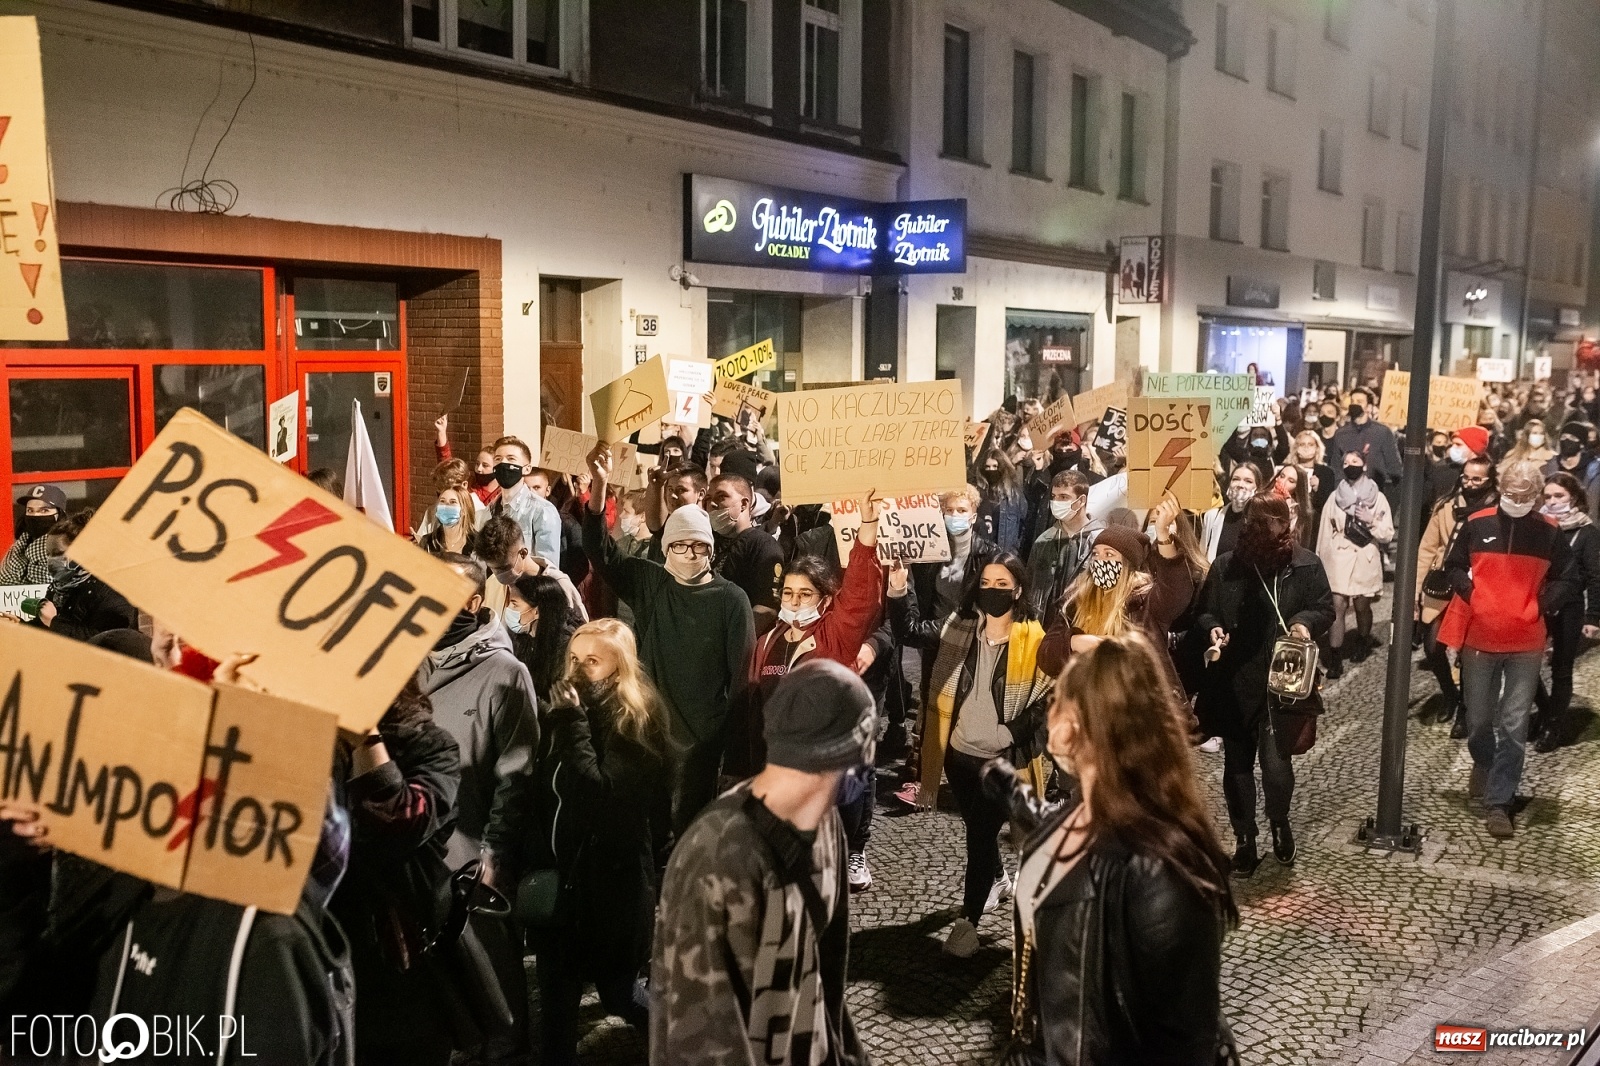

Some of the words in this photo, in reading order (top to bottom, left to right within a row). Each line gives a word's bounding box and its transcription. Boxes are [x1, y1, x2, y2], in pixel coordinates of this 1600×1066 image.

[751, 197, 818, 252] Jubiler
[817, 206, 878, 254] Złotnik
[894, 213, 949, 241] Jubiler
[894, 242, 950, 266] Złotnik
[643, 318, 657, 331] 36
[749, 343, 773, 365] -10%
[1042, 349, 1072, 361] PRZECENA
[723, 381, 740, 392] LOVE
[740, 385, 747, 393] &
[747, 387, 769, 401] PEACE
[1147, 376, 1170, 393] NIE
[1176, 375, 1255, 392] POTRZEBUJE
[786, 397, 819, 423] NO
[831, 388, 954, 420] KACZUSZKO
[1215, 396, 1250, 410] RUCHA
[1029, 397, 1066, 432] WELCOME
[1037, 424, 1048, 435] TO
[1049, 412, 1064, 427] HELL
[1133, 403, 1211, 439] DOŚĆ!
[1246, 410, 1267, 424] PRAW
[786, 425, 852, 450] KONIEC
[912, 420, 960, 441] TERAZ
[784, 452, 809, 475] CIĘ
[821, 448, 896, 471] ZAJEBIĄ
[904, 446, 953, 468] BABY
[32, 485, 45, 498] C
[895, 492, 940, 511] RIGHTS
[886, 512, 901, 527] IS
[901, 523, 941, 539] DICK
[120, 440, 260, 563] PiS
[277, 544, 448, 679] OFF
[878, 540, 926, 561] NERGY
[0, 668, 52, 803] AN
